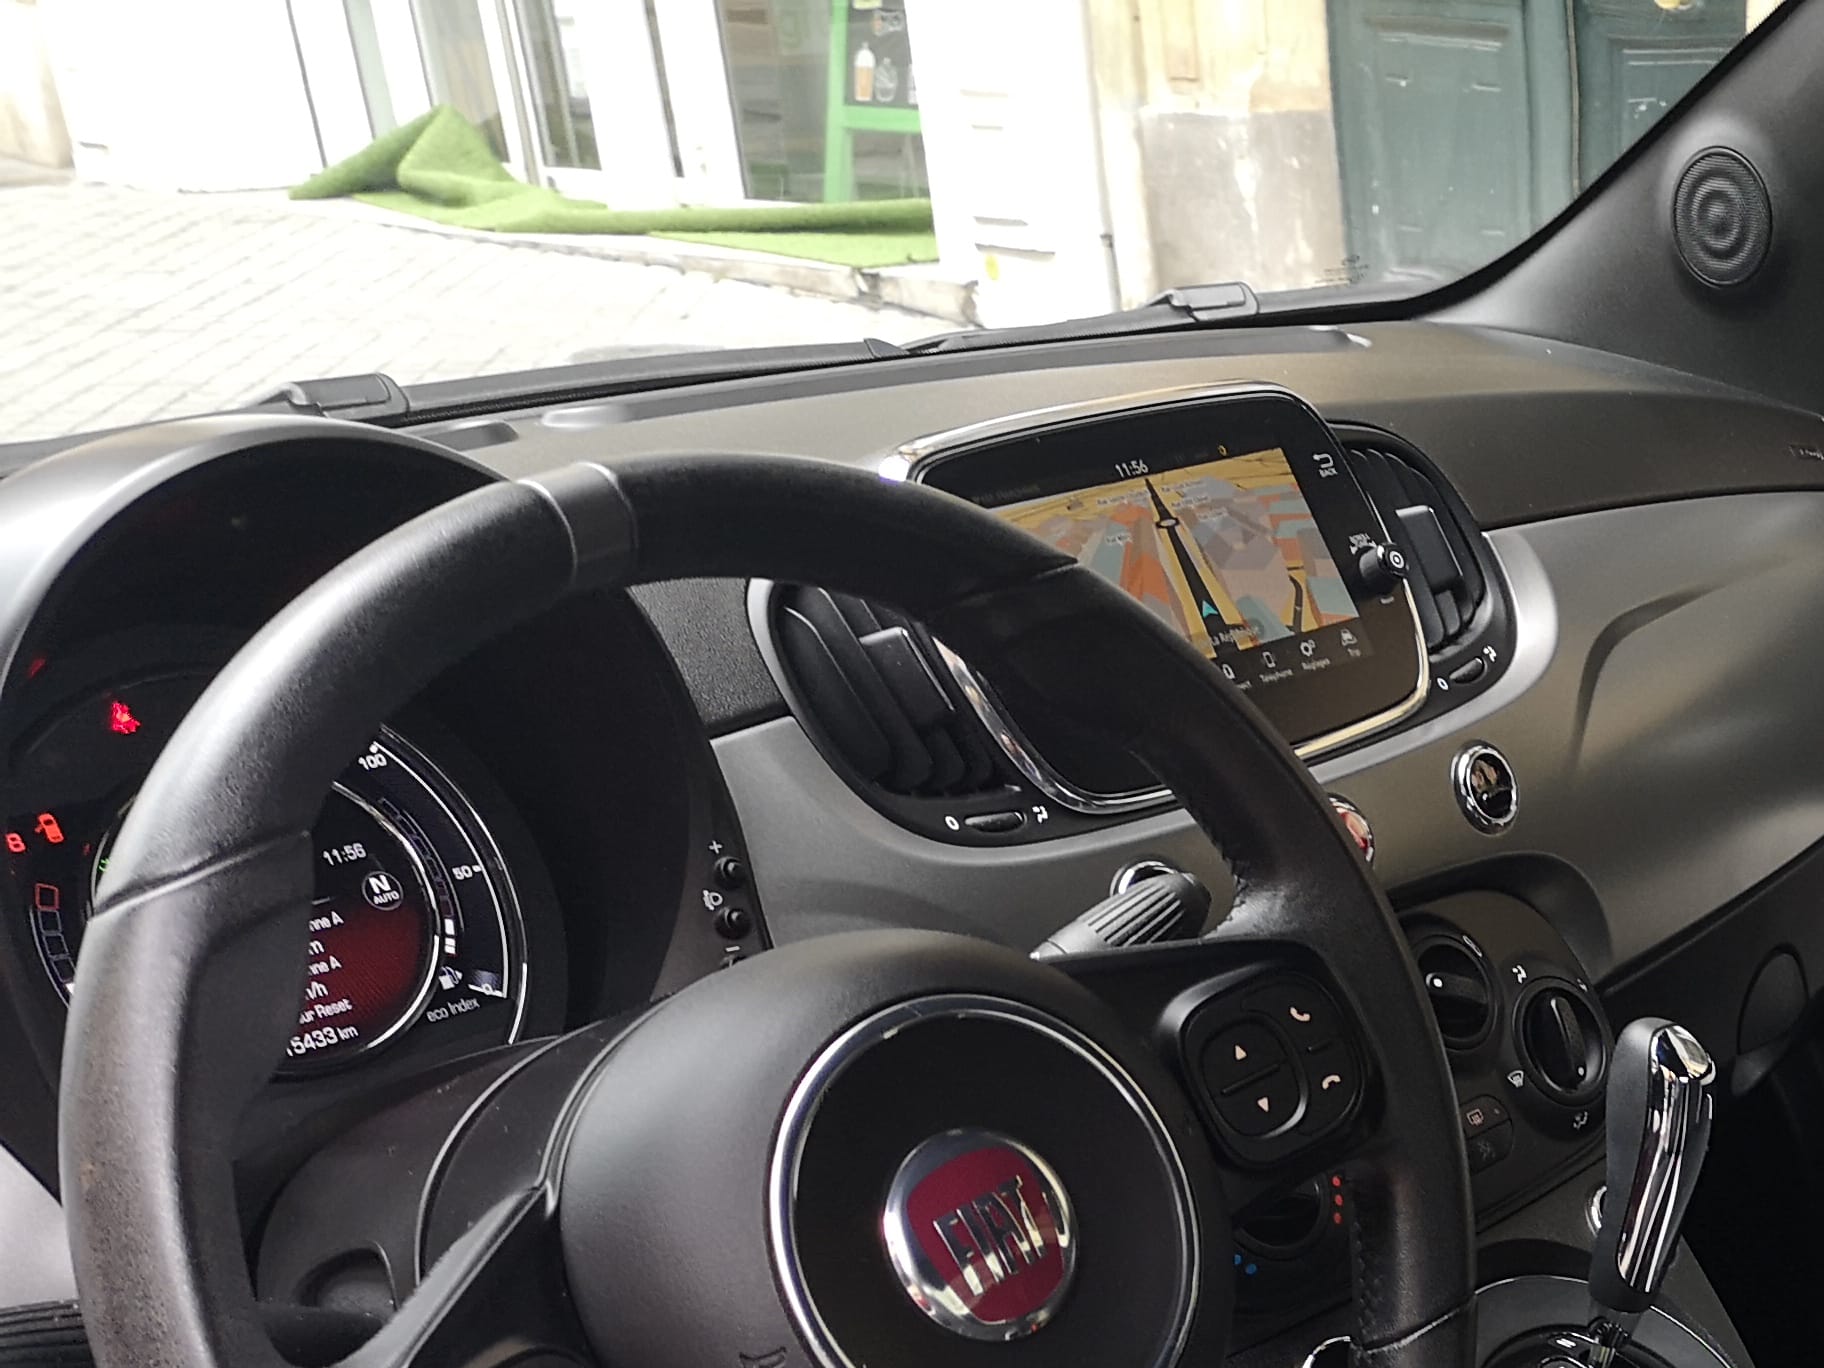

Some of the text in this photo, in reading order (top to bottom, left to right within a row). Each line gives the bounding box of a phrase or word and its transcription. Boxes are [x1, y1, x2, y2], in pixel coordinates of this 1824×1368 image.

[1114, 459, 1149, 478] 11:56
[358, 753, 388, 771] 100
[323, 843, 367, 866] 11:56
[452, 865, 473, 881] 50
[367, 874, 392, 894] N
[373, 890, 400, 906] AUTO
[314, 998, 353, 1019] Reset
[426, 1006, 449, 1022] eco
[338, 1025, 359, 1041] km
[932, 1174, 1046, 1297] FIAT
